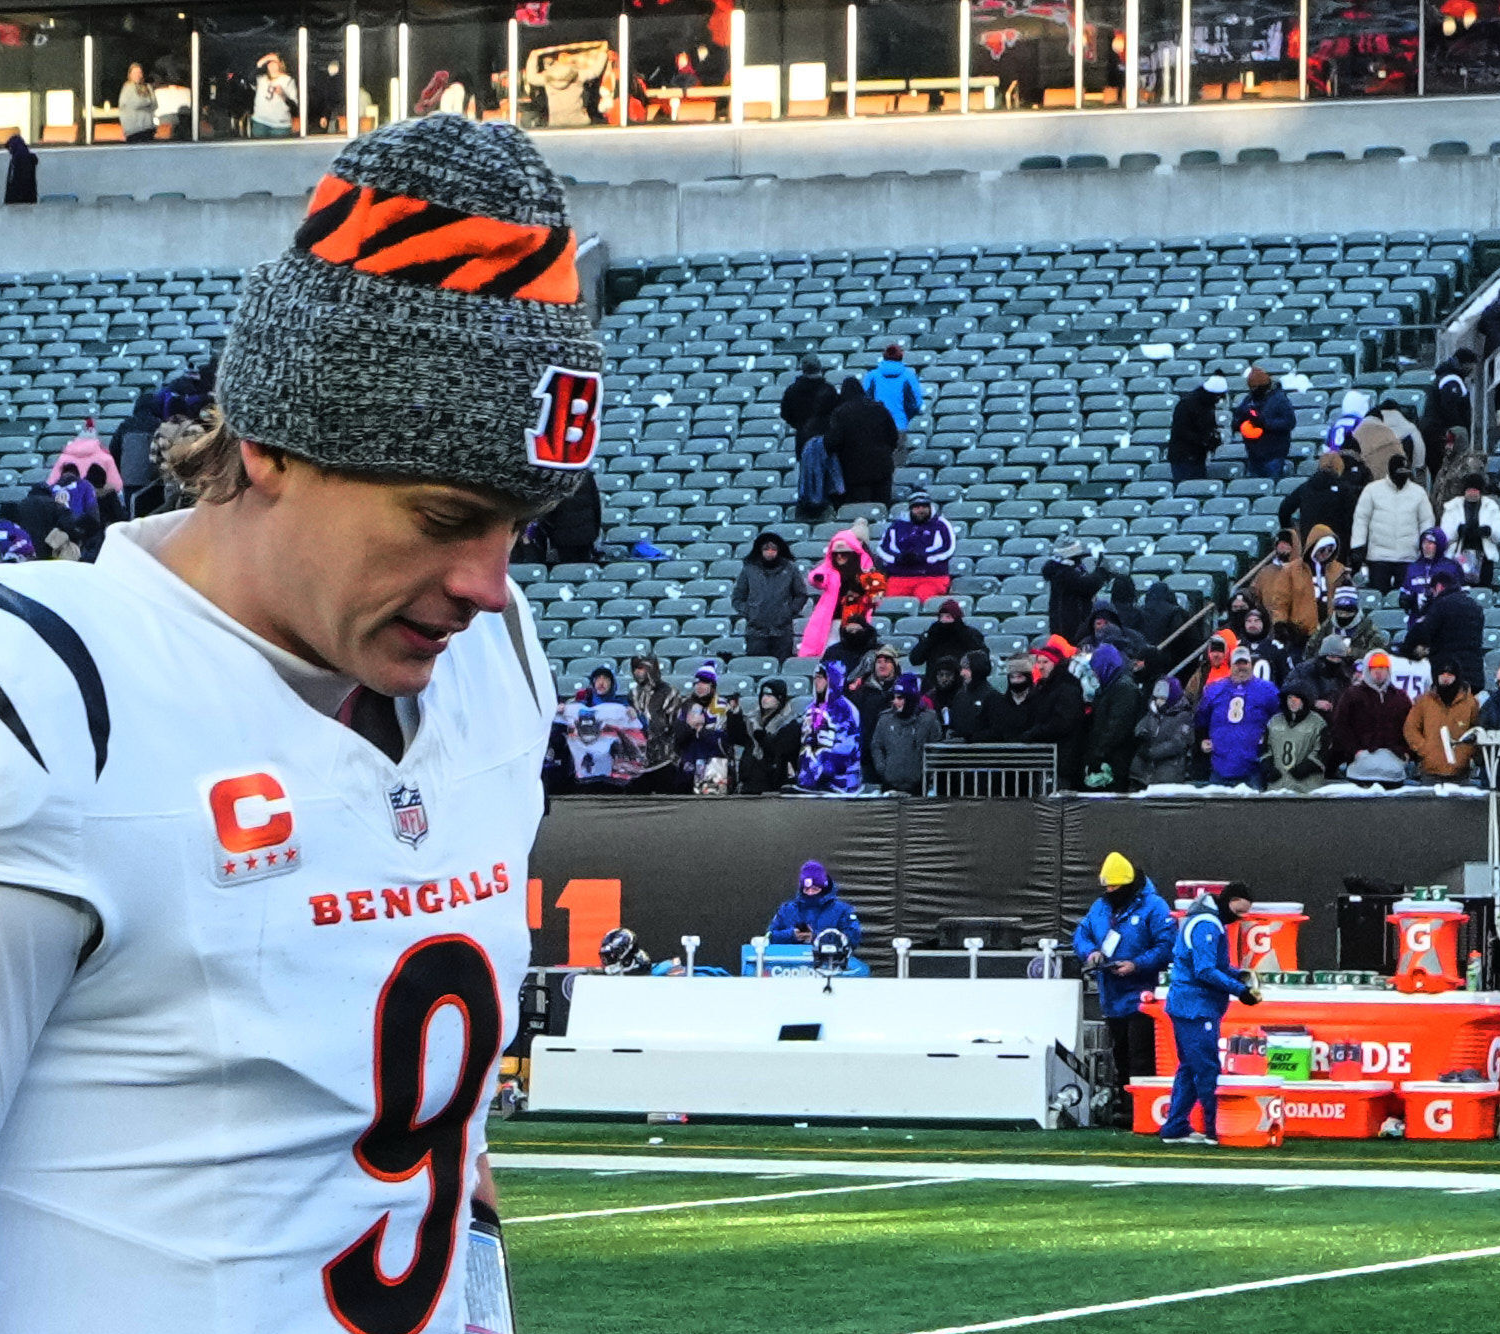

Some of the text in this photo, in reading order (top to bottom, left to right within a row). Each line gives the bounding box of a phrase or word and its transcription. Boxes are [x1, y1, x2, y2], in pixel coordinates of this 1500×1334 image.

[1228, 697, 1245, 724] 8
[1282, 740, 1294, 767] 8
[209, 773, 293, 853] C
[395, 805, 428, 835] NFL
[308, 861, 512, 927] BENGALS
[1247, 925, 1272, 954] G
[1406, 923, 1431, 952] G
[1284, 1102, 1346, 1119] ORADE
[1423, 1101, 1453, 1133] G
